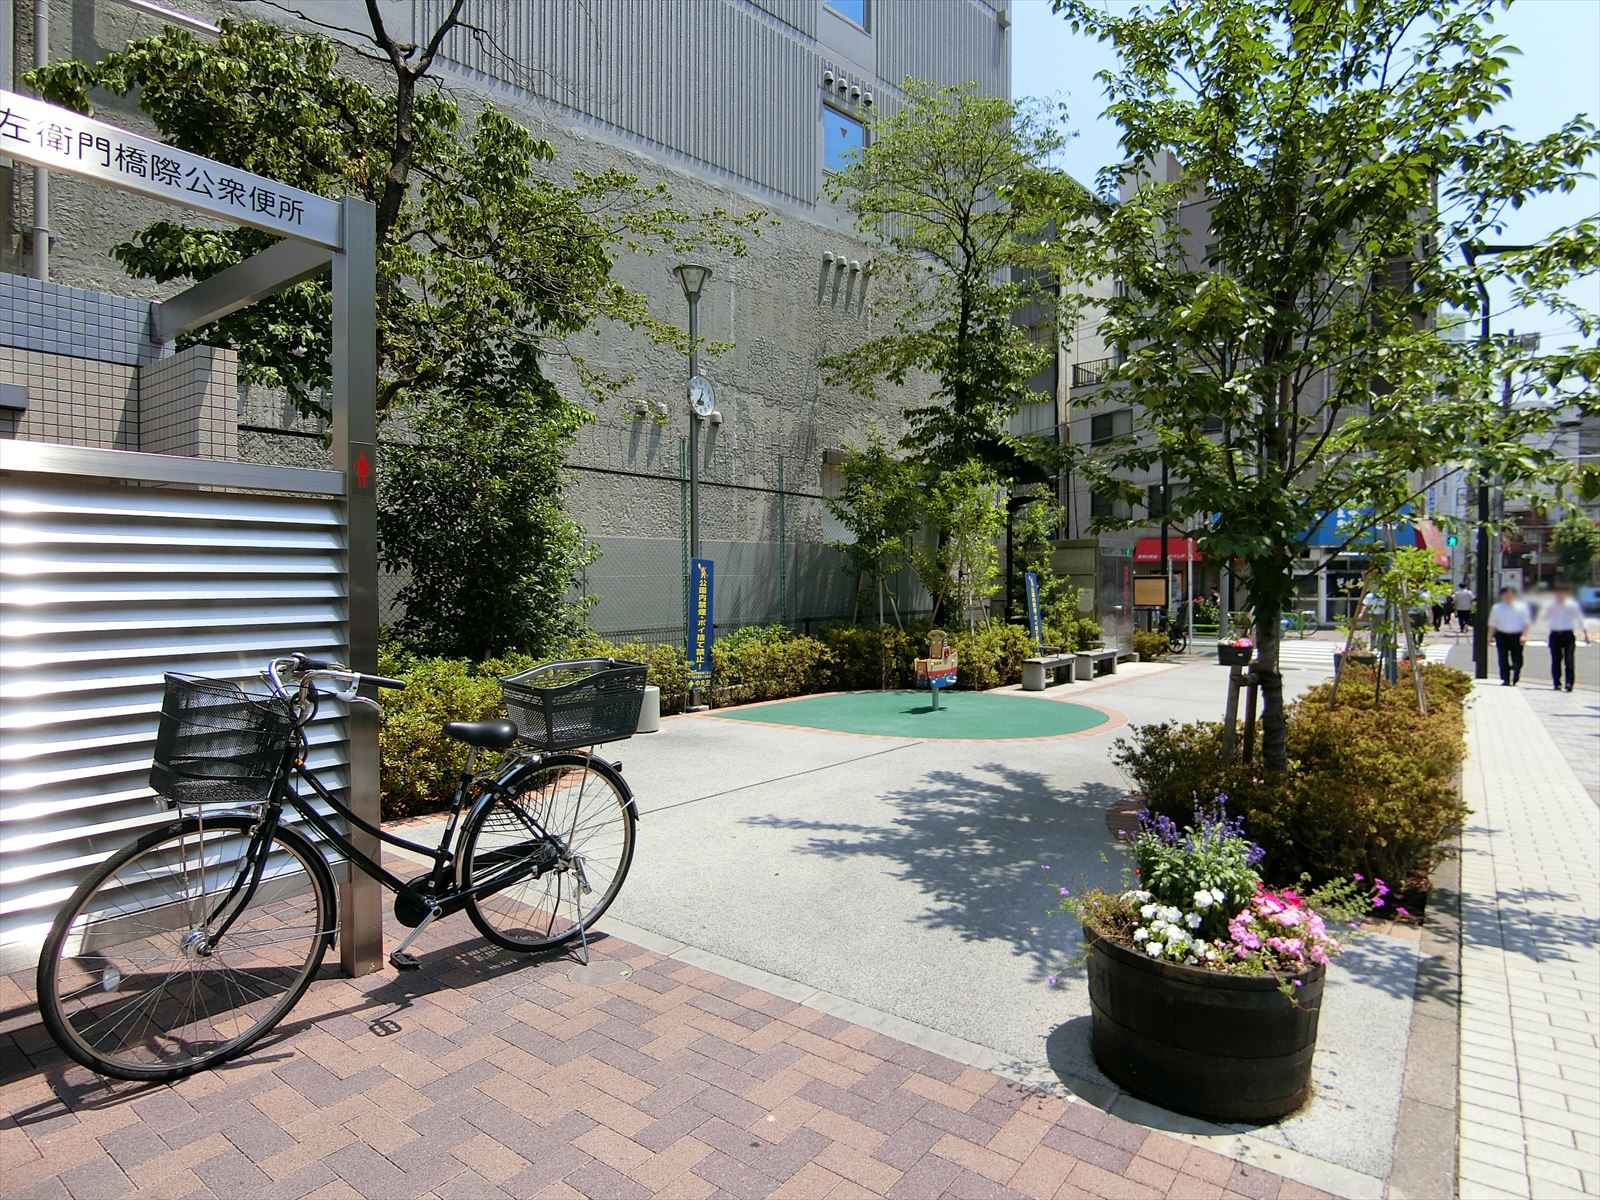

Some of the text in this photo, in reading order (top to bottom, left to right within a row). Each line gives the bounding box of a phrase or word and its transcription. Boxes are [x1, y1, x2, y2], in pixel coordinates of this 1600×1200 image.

[0, 106, 305, 226] 左衛門橋際公衆便所
